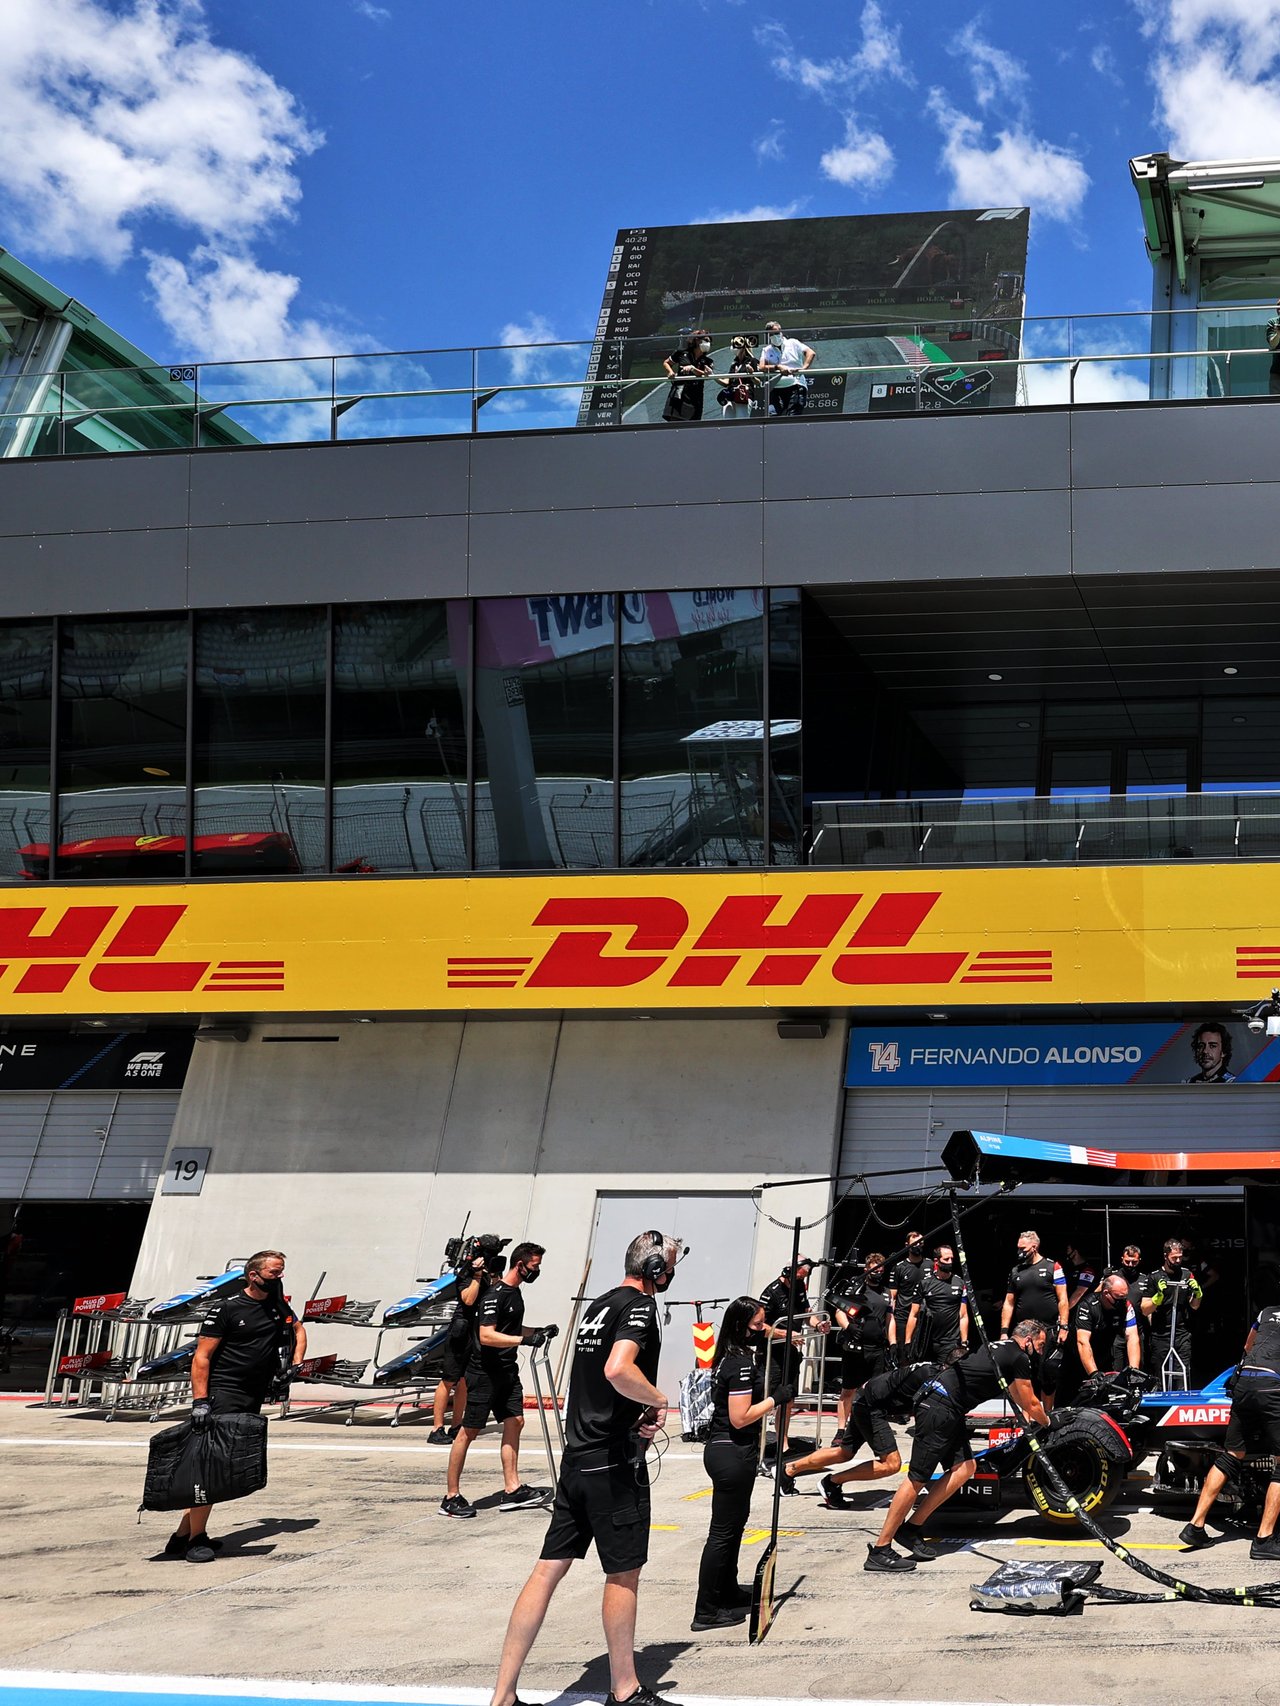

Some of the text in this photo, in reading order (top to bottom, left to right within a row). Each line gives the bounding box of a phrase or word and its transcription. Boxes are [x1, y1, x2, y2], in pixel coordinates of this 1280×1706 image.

[524, 892, 969, 990] DHL
[130, 1052, 166, 1062] F1
[868, 1043, 1142, 1072] 14 FERNANDO ALONSO
[174, 1160, 199, 1181] 19
[83, 1298, 97, 1306] PLUG
[75, 1303, 98, 1311] POWER
[306, 1306, 325, 1314] POWER
[69, 1357, 84, 1365] PLUG
[61, 1362, 83, 1371] POWER
[919, 1486, 993, 1495] AINE
[1026, 1472, 1049, 1511] PIRELLI
